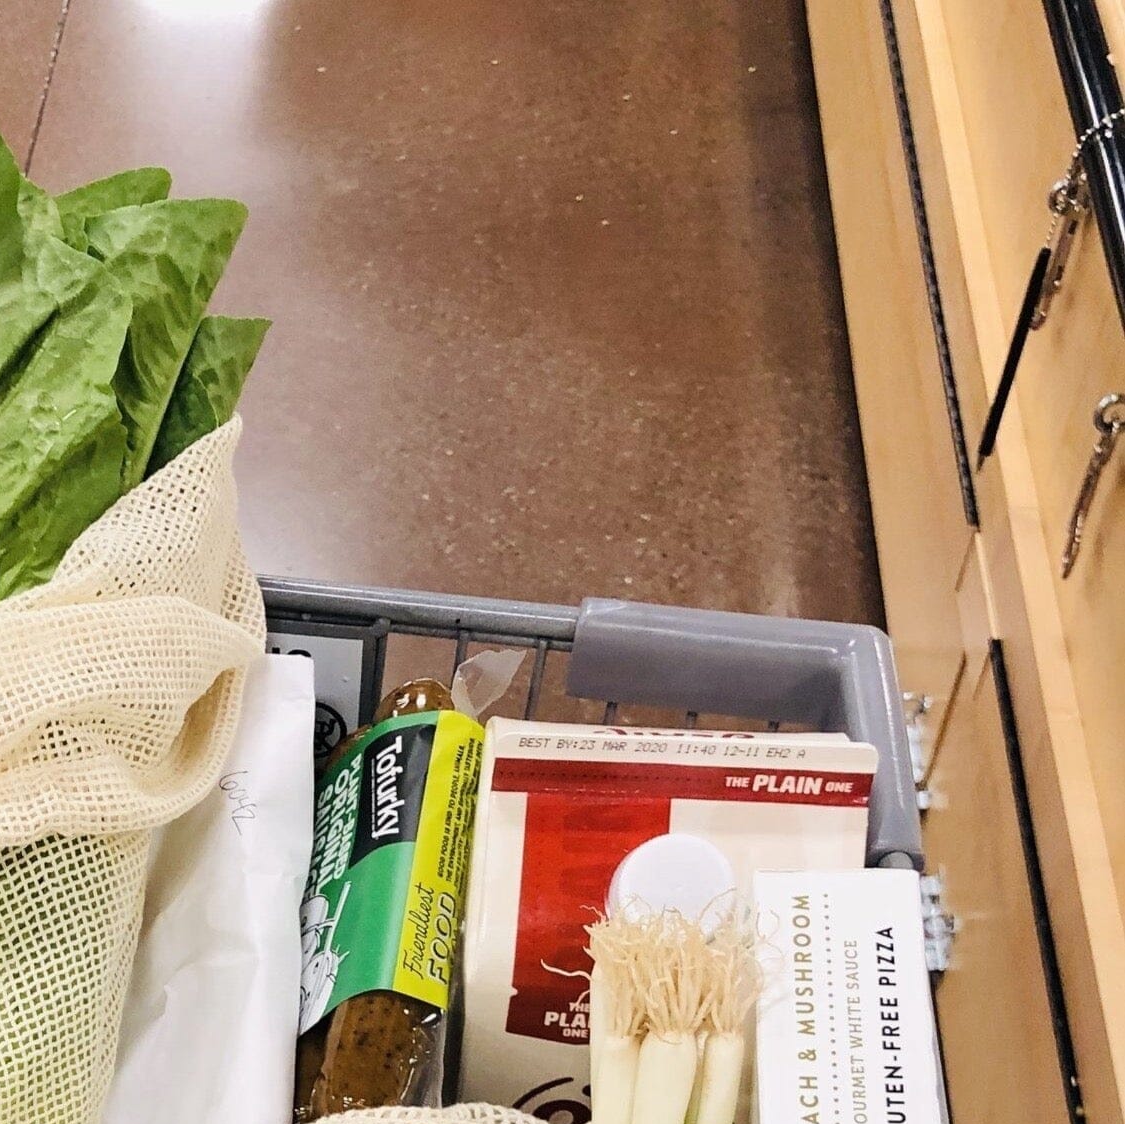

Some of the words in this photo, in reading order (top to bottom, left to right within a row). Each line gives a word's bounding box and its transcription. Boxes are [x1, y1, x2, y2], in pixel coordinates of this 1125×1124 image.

[519, 737, 550, 749] BEST
[602, 740, 627, 752] MAR
[634, 742, 668, 753] 2020
[676, 743, 716, 756] 11:40
[724, 746, 758, 758] 12-11
[371, 735, 405, 840] Tofurky
[725, 776, 750, 788] THE
[752, 774, 823, 795] PLAIN
[825, 781, 854, 793] ONE
[315, 768, 350, 896] ORIGINAL
[333, 753, 363, 880] PLANT-BASED
[403, 882, 434, 980] Friendliest
[428, 892, 456, 985] FOOD
[876, 926, 897, 987] PIZZA
[792, 894, 816, 1035] MUSHROOM
[844, 940, 860, 990] SAUCE
[544, 1011, 590, 1028] PLA
[563, 1028, 588, 1038] ONE
[569, 1002, 590, 1013] THE
[847, 996, 863, 1049] WHITE
[798, 1048, 817, 1061] &
